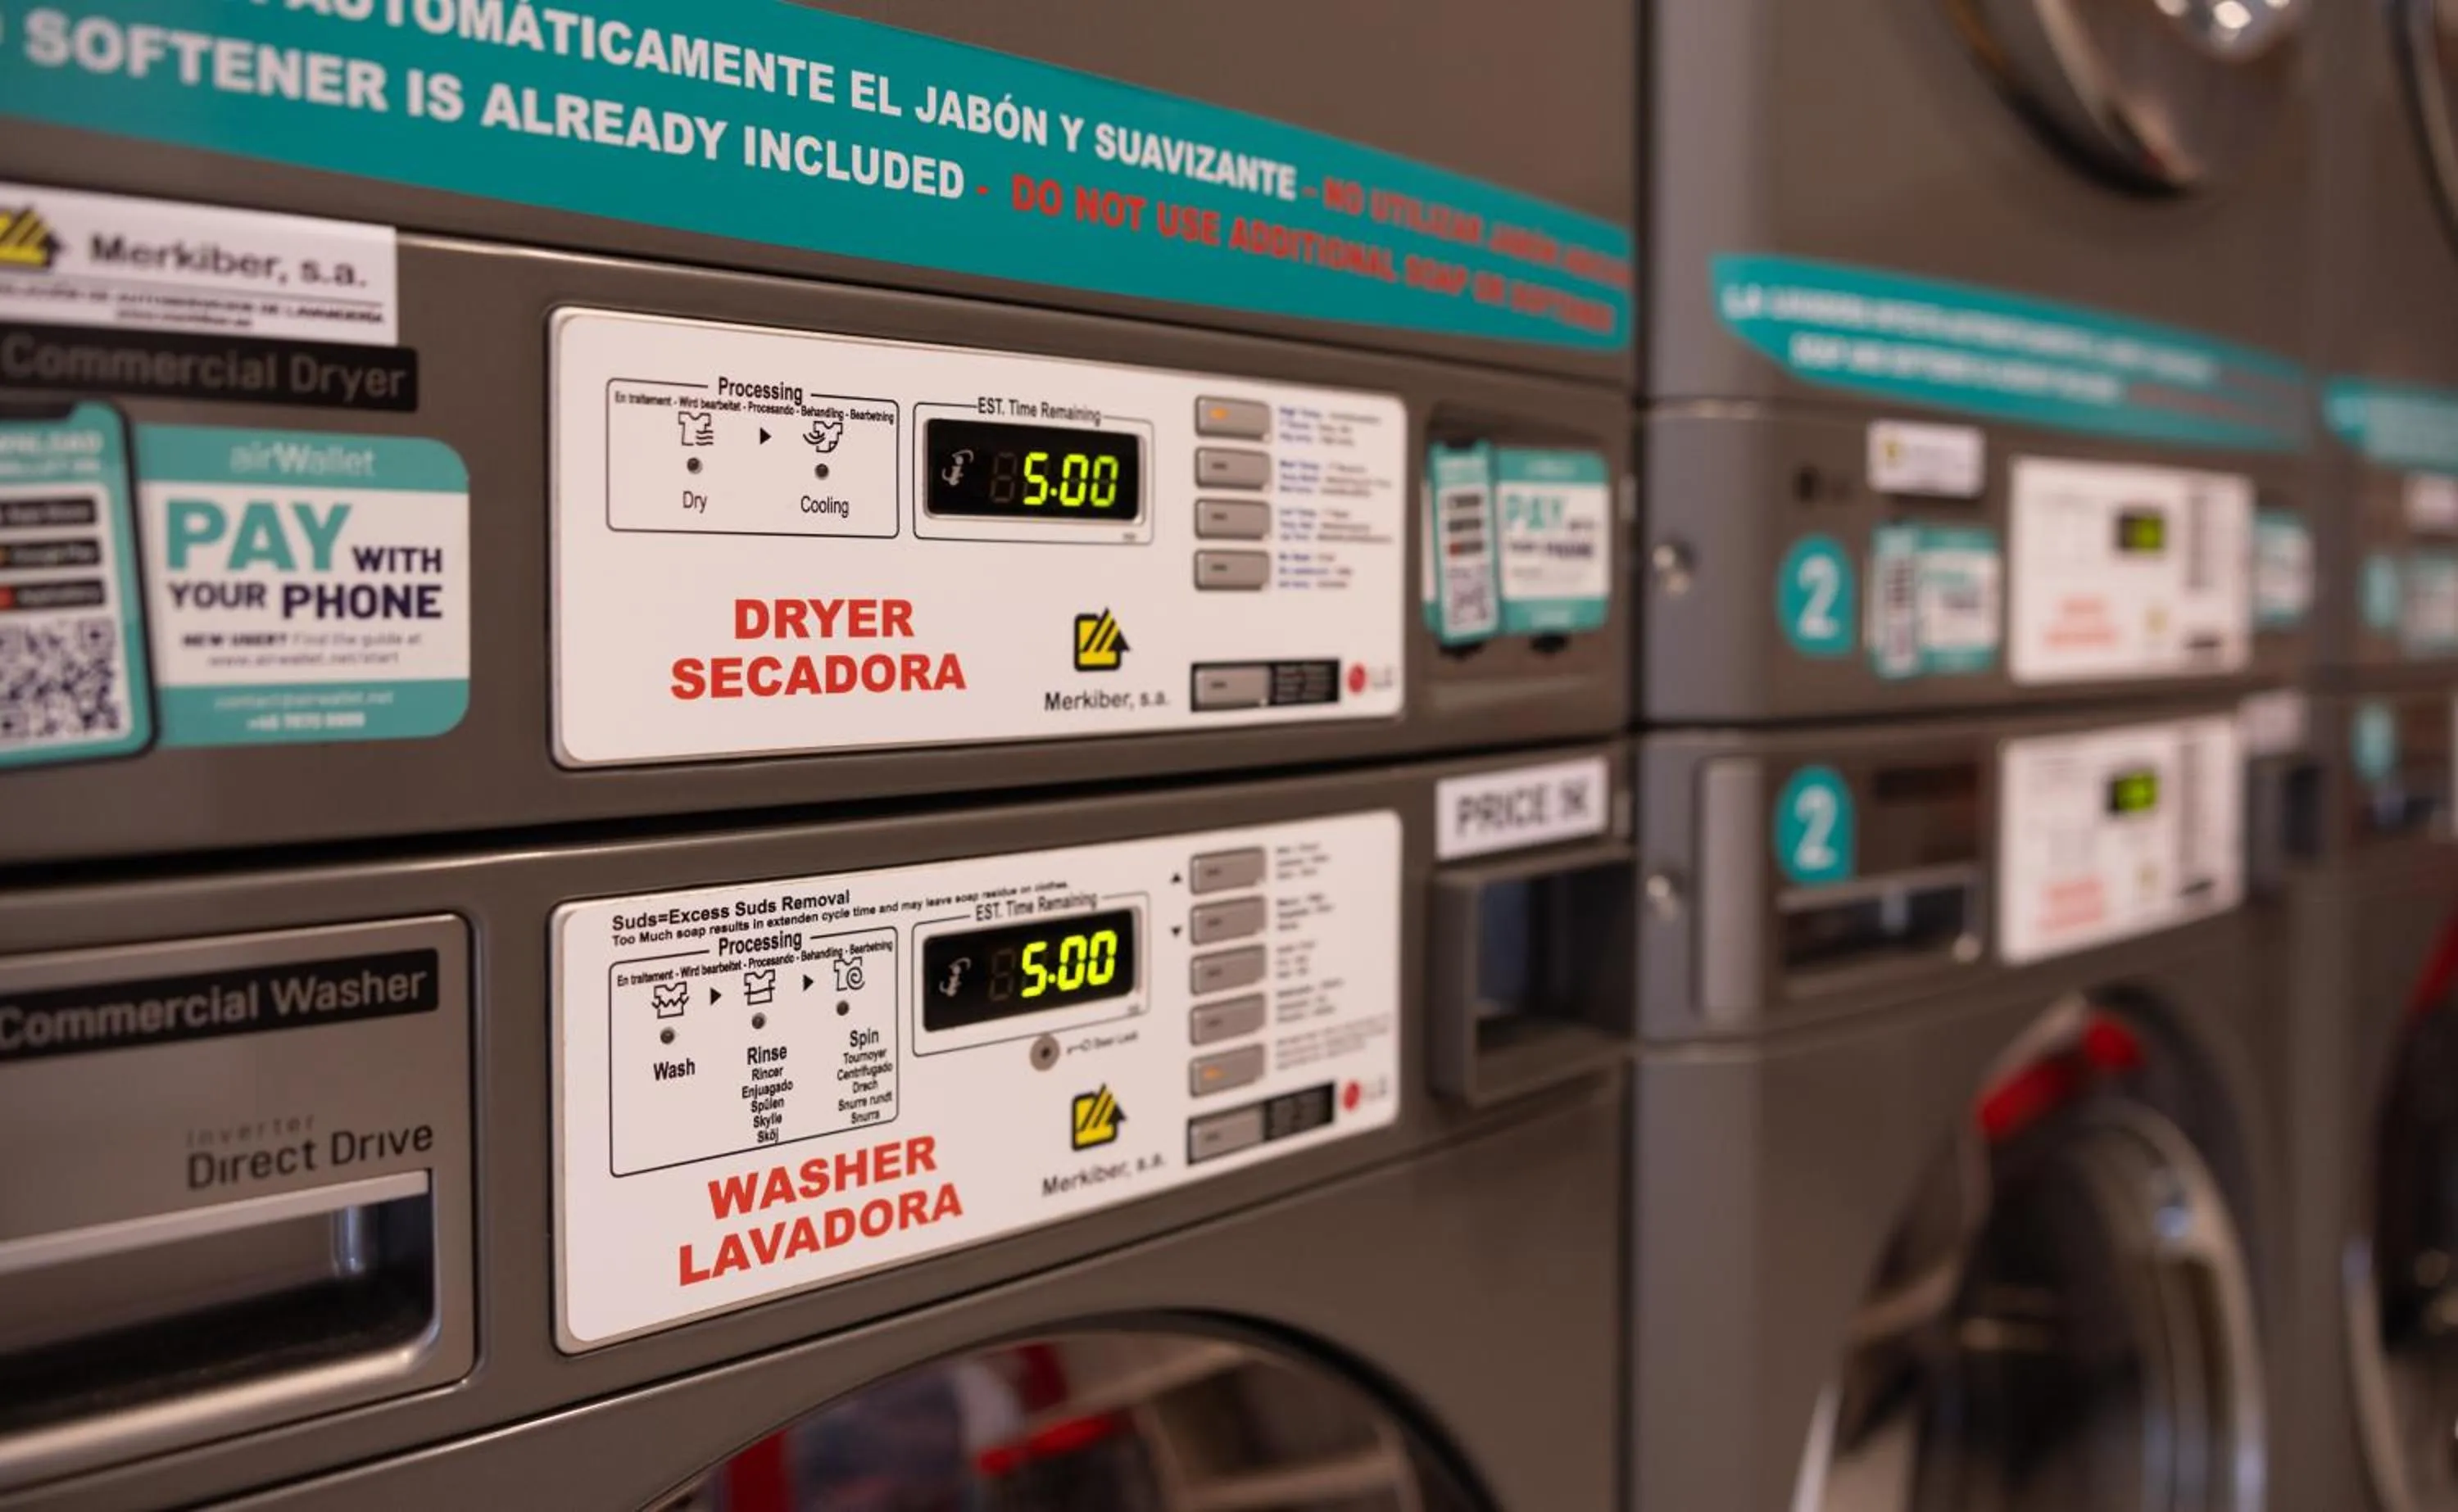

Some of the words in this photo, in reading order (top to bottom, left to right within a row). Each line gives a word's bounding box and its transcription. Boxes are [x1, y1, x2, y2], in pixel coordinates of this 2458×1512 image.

[24, 7, 388, 112] SOFTENER
[406, 68, 465, 121] IS
[480, 82, 728, 160] ALREADY
[743, 125, 964, 199] INCLUDED
[1010, 174, 1062, 216] DO
[1075, 187, 1145, 230] NOT
[1156, 201, 1221, 246] USE
[1229, 217, 1395, 283] ADDITIONAL
[850, 70, 901, 116] EL
[914, 86, 1047, 146] JABÓN
[1061, 115, 1084, 152] Y
[1095, 122, 1296, 201] SUAVIZANTE
[1322, 176, 1364, 215] NO
[90, 233, 288, 285] Merkiber,
[300, 260, 367, 287] s.a.
[2, 332, 276, 390] Commercial
[289, 355, 406, 401] Dryer
[719, 377, 803, 405] Processing
[977, 396, 1005, 415] EST.
[1009, 399, 1037, 418] Time
[1041, 401, 1102, 427] Remaining
[230, 441, 374, 477] airWallet
[682, 490, 708, 514] Dry
[800, 496, 849, 518] Cooling
[166, 499, 352, 572] PAY
[352, 546, 442, 573] WITH
[169, 582, 266, 610] YOUR
[281, 584, 442, 620] PHONE
[1797, 551, 1842, 640] 2
[734, 599, 914, 639] DRYER
[670, 653, 967, 700] SECADORA
[1044, 691, 1135, 712] Merkiber,
[1140, 690, 1170, 707] s.a.
[1793, 784, 1839, 871] 2
[612, 906, 729, 931] Suds=Excess
[735, 899, 777, 916] Suds
[782, 889, 850, 911] Removal
[612, 935, 635, 946] Too
[639, 930, 673, 943] Much
[677, 926, 705, 938] soap
[709, 921, 749, 935] results
[753, 918, 764, 929] in
[822, 908, 850, 923] cycle
[853, 904, 875, 917] time
[879, 901, 898, 913] and
[901, 901, 922, 912] may
[926, 897, 951, 907] leave
[955, 893, 978, 903] soap
[982, 888, 1017, 899] residue
[976, 903, 1002, 921] EST.
[1007, 899, 1033, 915] Time
[1038, 892, 1096, 912] Remaining
[719, 930, 801, 957] Processing
[617, 975, 628, 986] En
[801, 946, 842, 962] Behandling
[0, 985, 258, 1051] Commercial
[271, 969, 427, 1016] Washer
[747, 1046, 787, 1065] Rinse
[850, 1028, 879, 1050] Spin
[654, 1058, 696, 1081] Wash
[751, 1066, 783, 1081] Rincer
[837, 1062, 892, 1080] Centrifugado
[741, 1079, 793, 1099] Enjuagado
[753, 1112, 782, 1129] Skylle
[187, 1139, 317, 1191] Direct
[330, 1125, 433, 1167] Drive
[708, 1136, 936, 1220] WASHER
[1042, 1161, 1131, 1197] Merkiber,
[679, 1182, 963, 1286] LAVADORA
